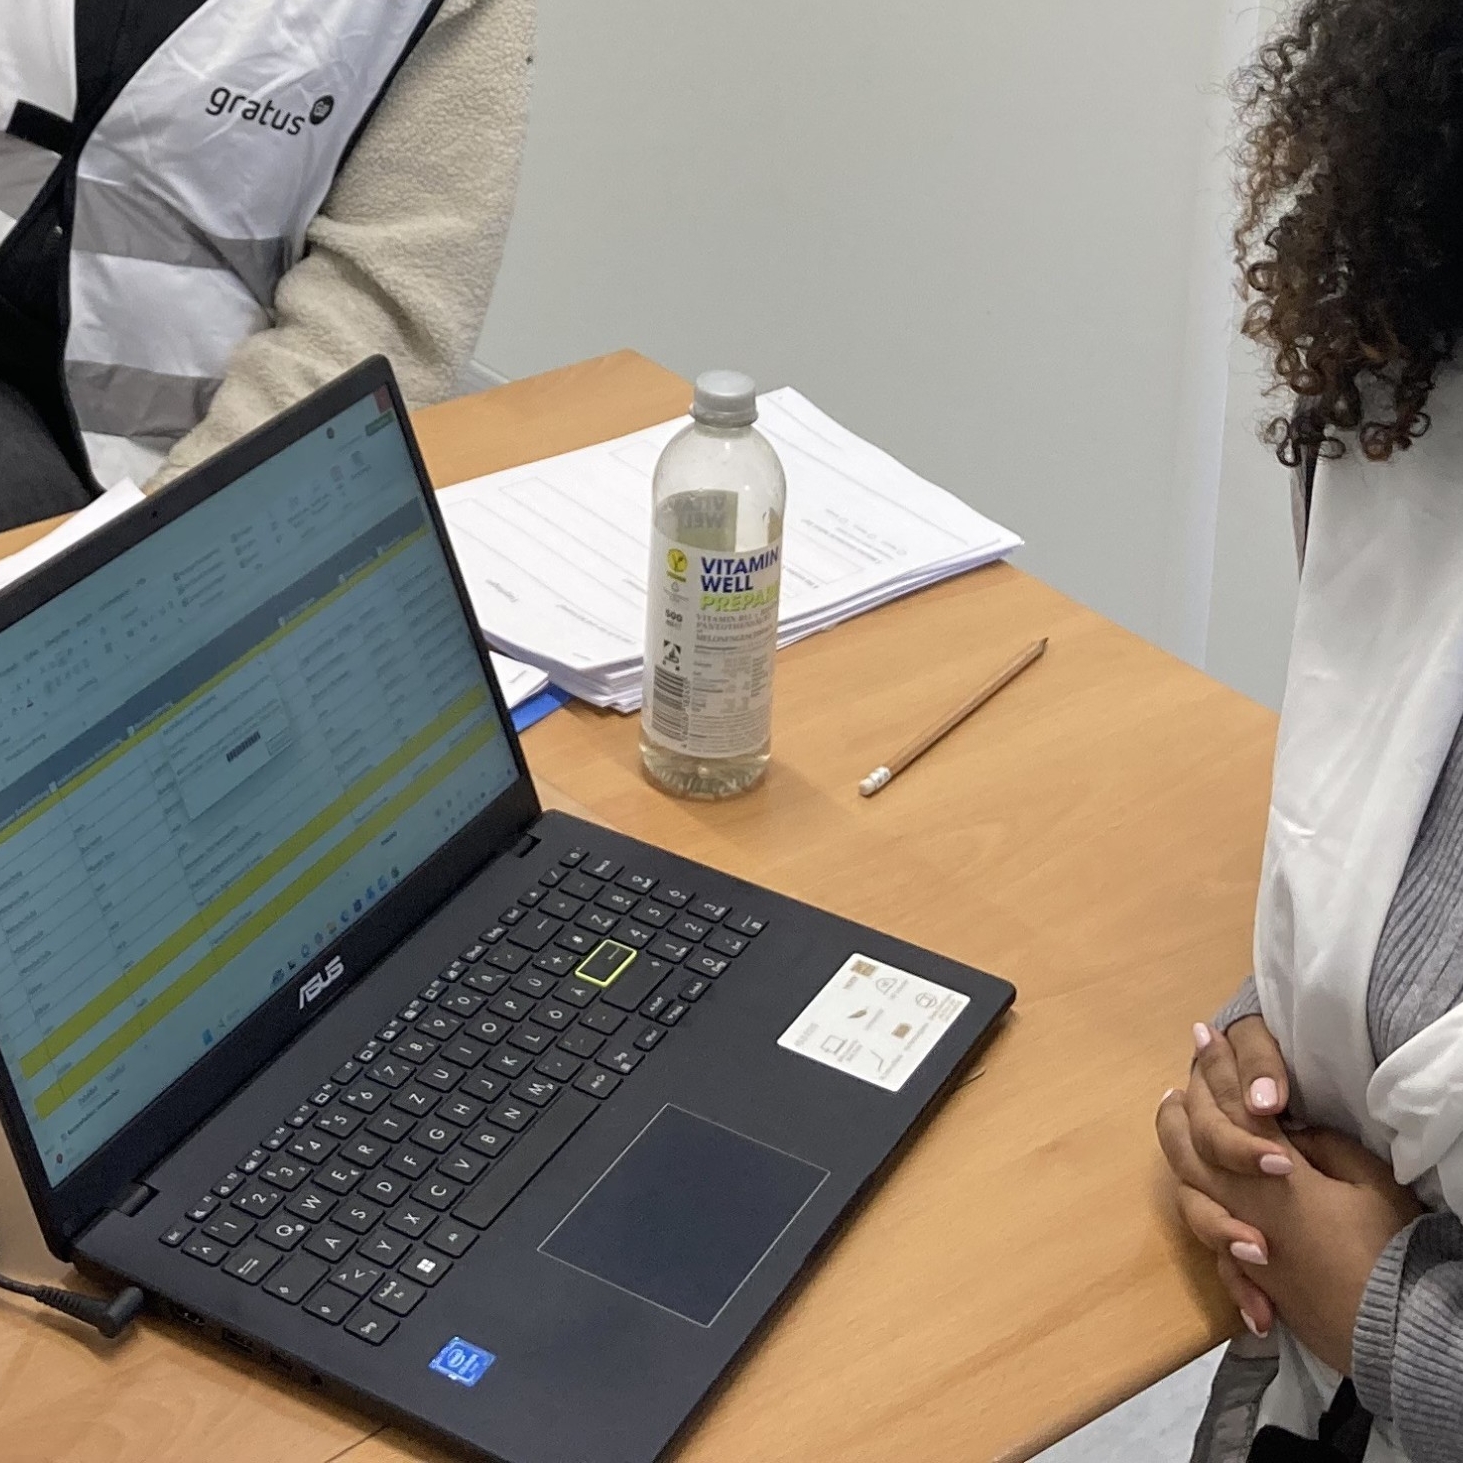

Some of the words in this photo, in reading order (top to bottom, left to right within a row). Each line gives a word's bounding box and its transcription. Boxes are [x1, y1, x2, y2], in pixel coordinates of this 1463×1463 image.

[205, 86, 306, 136] gratus
[700, 545, 780, 576] VITAMIN
[700, 574, 754, 594] WELL
[299, 955, 345, 1010] ASUS
